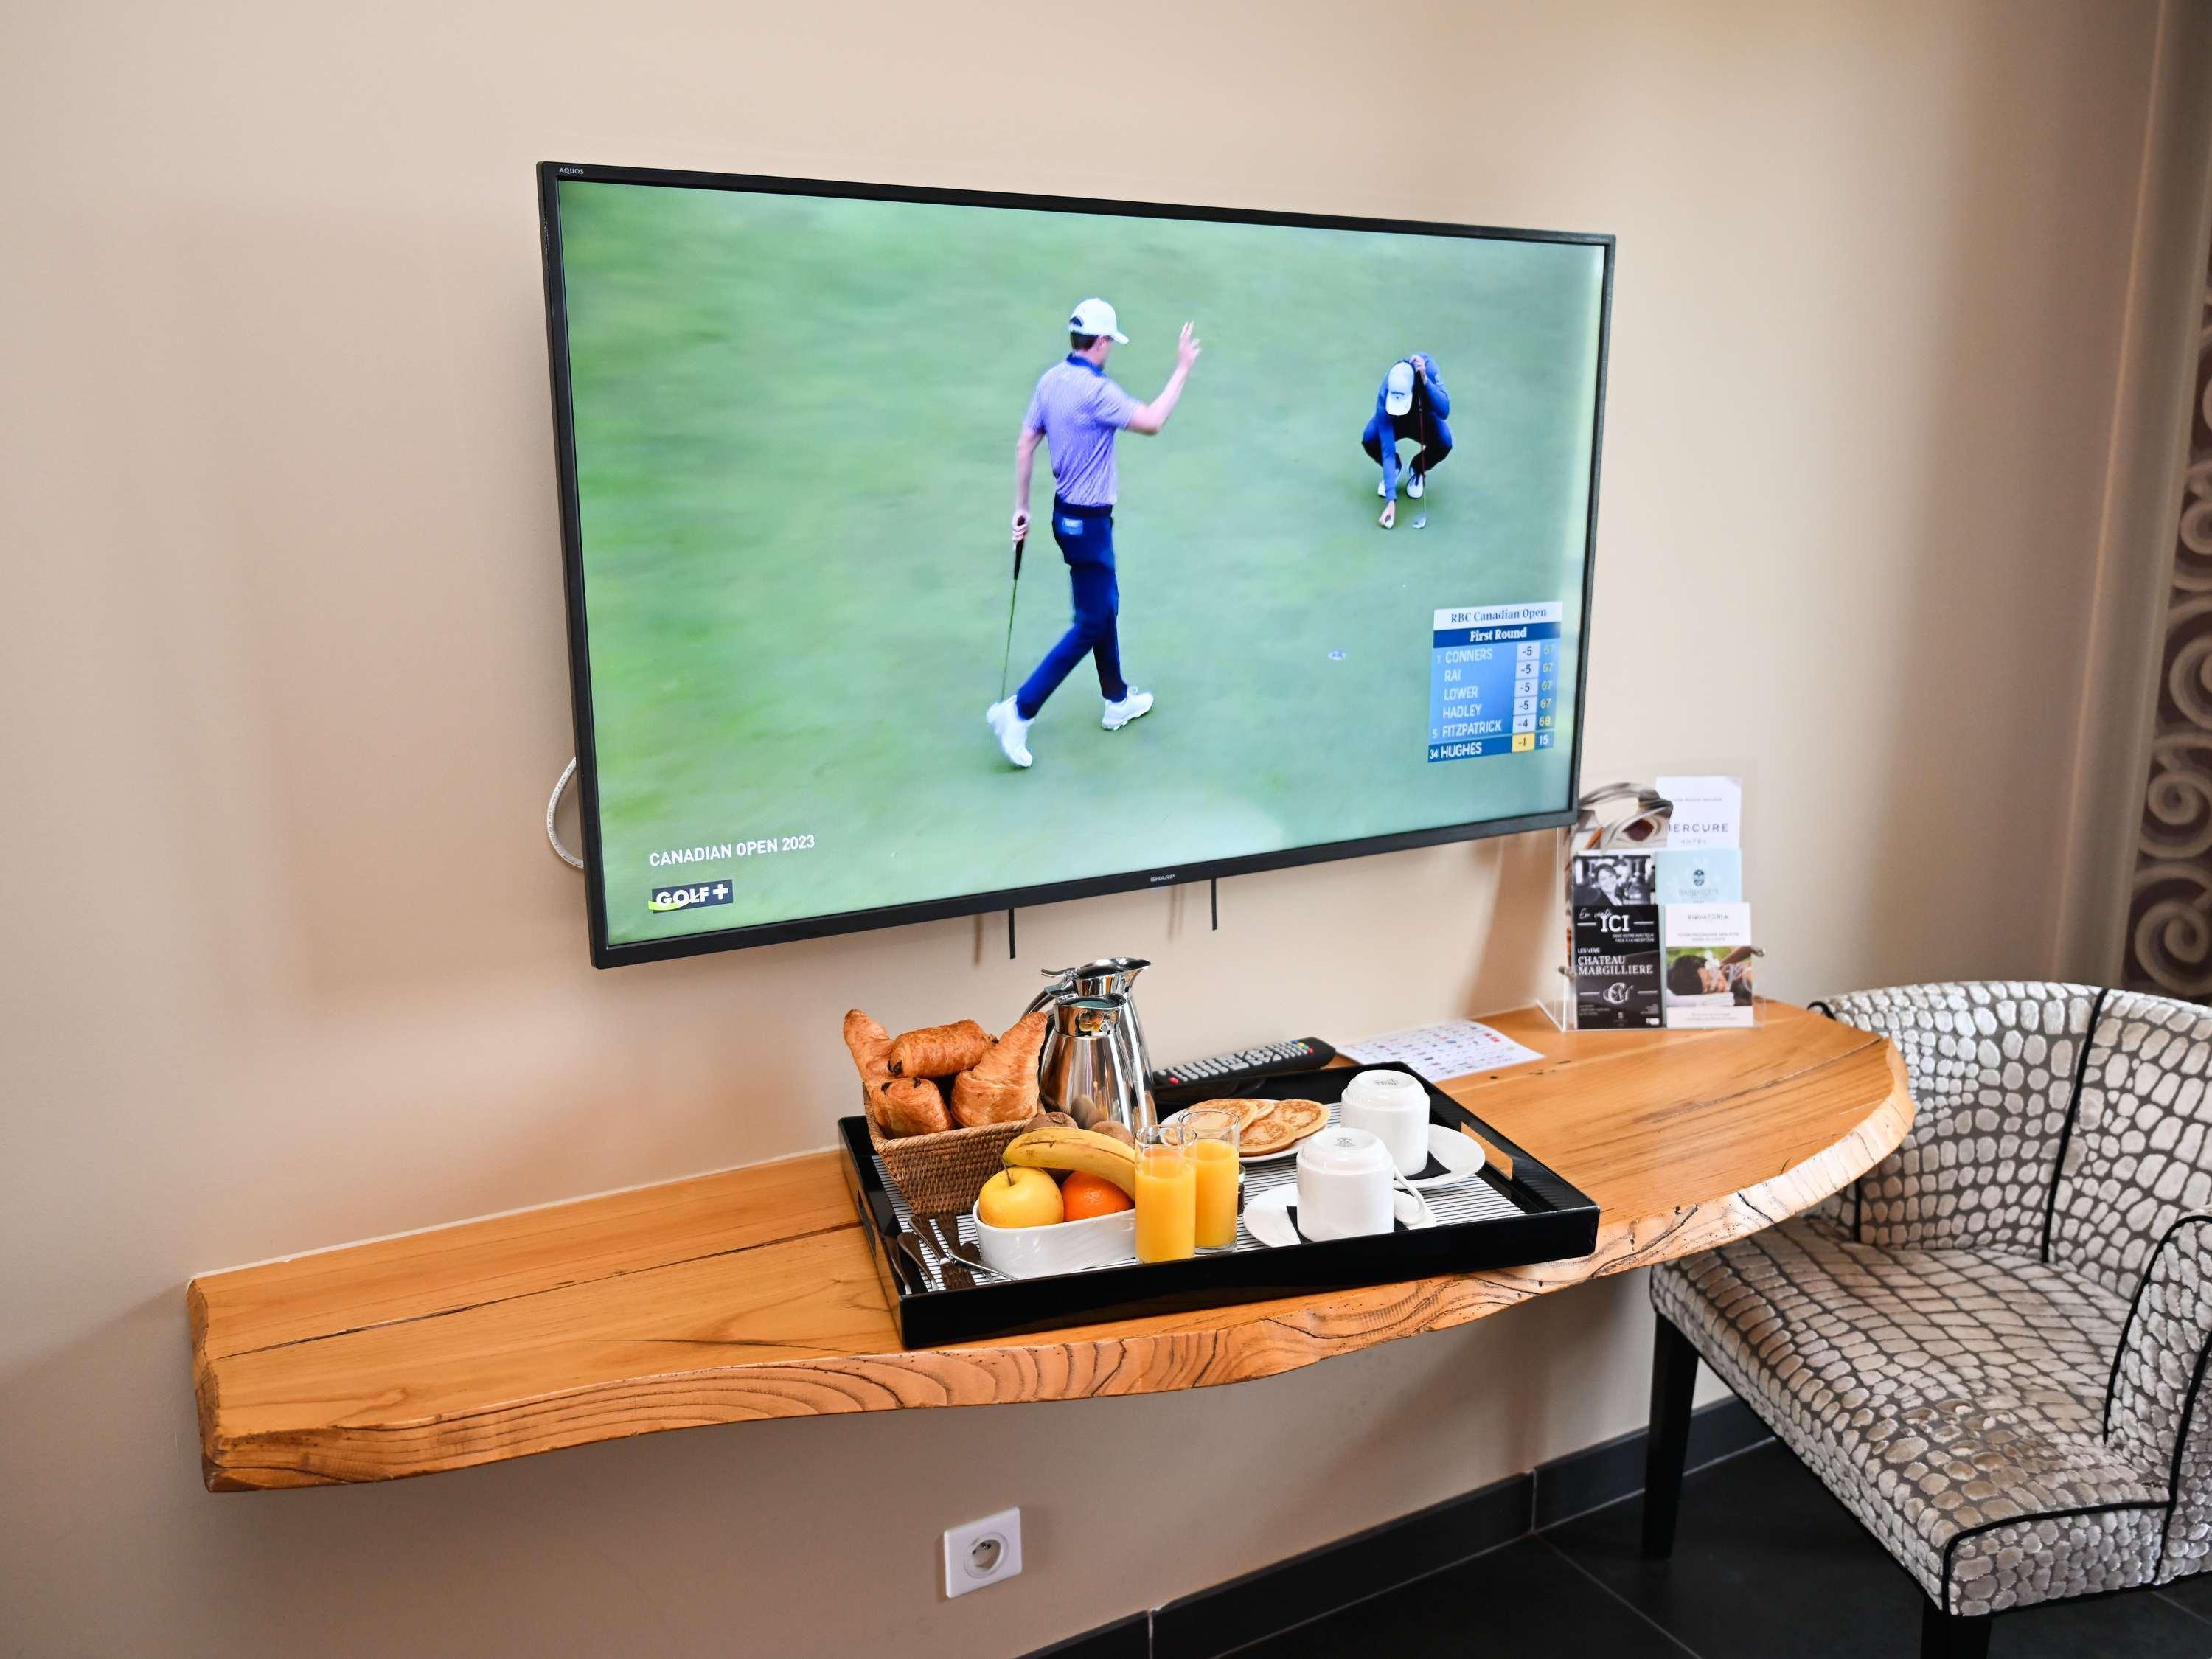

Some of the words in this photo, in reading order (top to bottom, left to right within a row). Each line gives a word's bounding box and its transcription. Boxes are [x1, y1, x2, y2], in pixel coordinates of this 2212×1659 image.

[1451, 613, 1471, 623] RBC
[1474, 611, 1520, 622] Canadian
[1523, 608, 1546, 620] Open
[1470, 630, 1493, 642] First
[1495, 627, 1527, 640] Round
[1445, 648, 1492, 664] CONNERS
[1522, 646, 1532, 655] -5
[1444, 669, 1461, 682] RAI
[1521, 664, 1531, 674] -5
[1444, 686, 1478, 700] LOWER
[1520, 682, 1530, 692] -5
[1443, 703, 1482, 719] HADLEY
[1519, 700, 1529, 710] -5
[1442, 720, 1502, 737] FITZPATRICK
[1517, 718, 1528, 727] -4
[1539, 717, 1551, 726] 68
[1429, 749, 1439, 759] 34
[1441, 742, 1482, 758] HUGHES
[1540, 735, 1548, 745] 15
[1668, 823, 1728, 832] ERCURE
[650, 844, 732, 867] CANADIAN
[737, 838, 778, 856] OPEN
[782, 835, 815, 851] 2023
[1150, 874, 1175, 883] SHARP
[655, 887, 709, 907] GOLF
[1600, 914, 1630, 933] ICI
[1578, 956, 1625, 965] CHATEAU
[1579, 964, 1653, 975] MARGILLIERE
